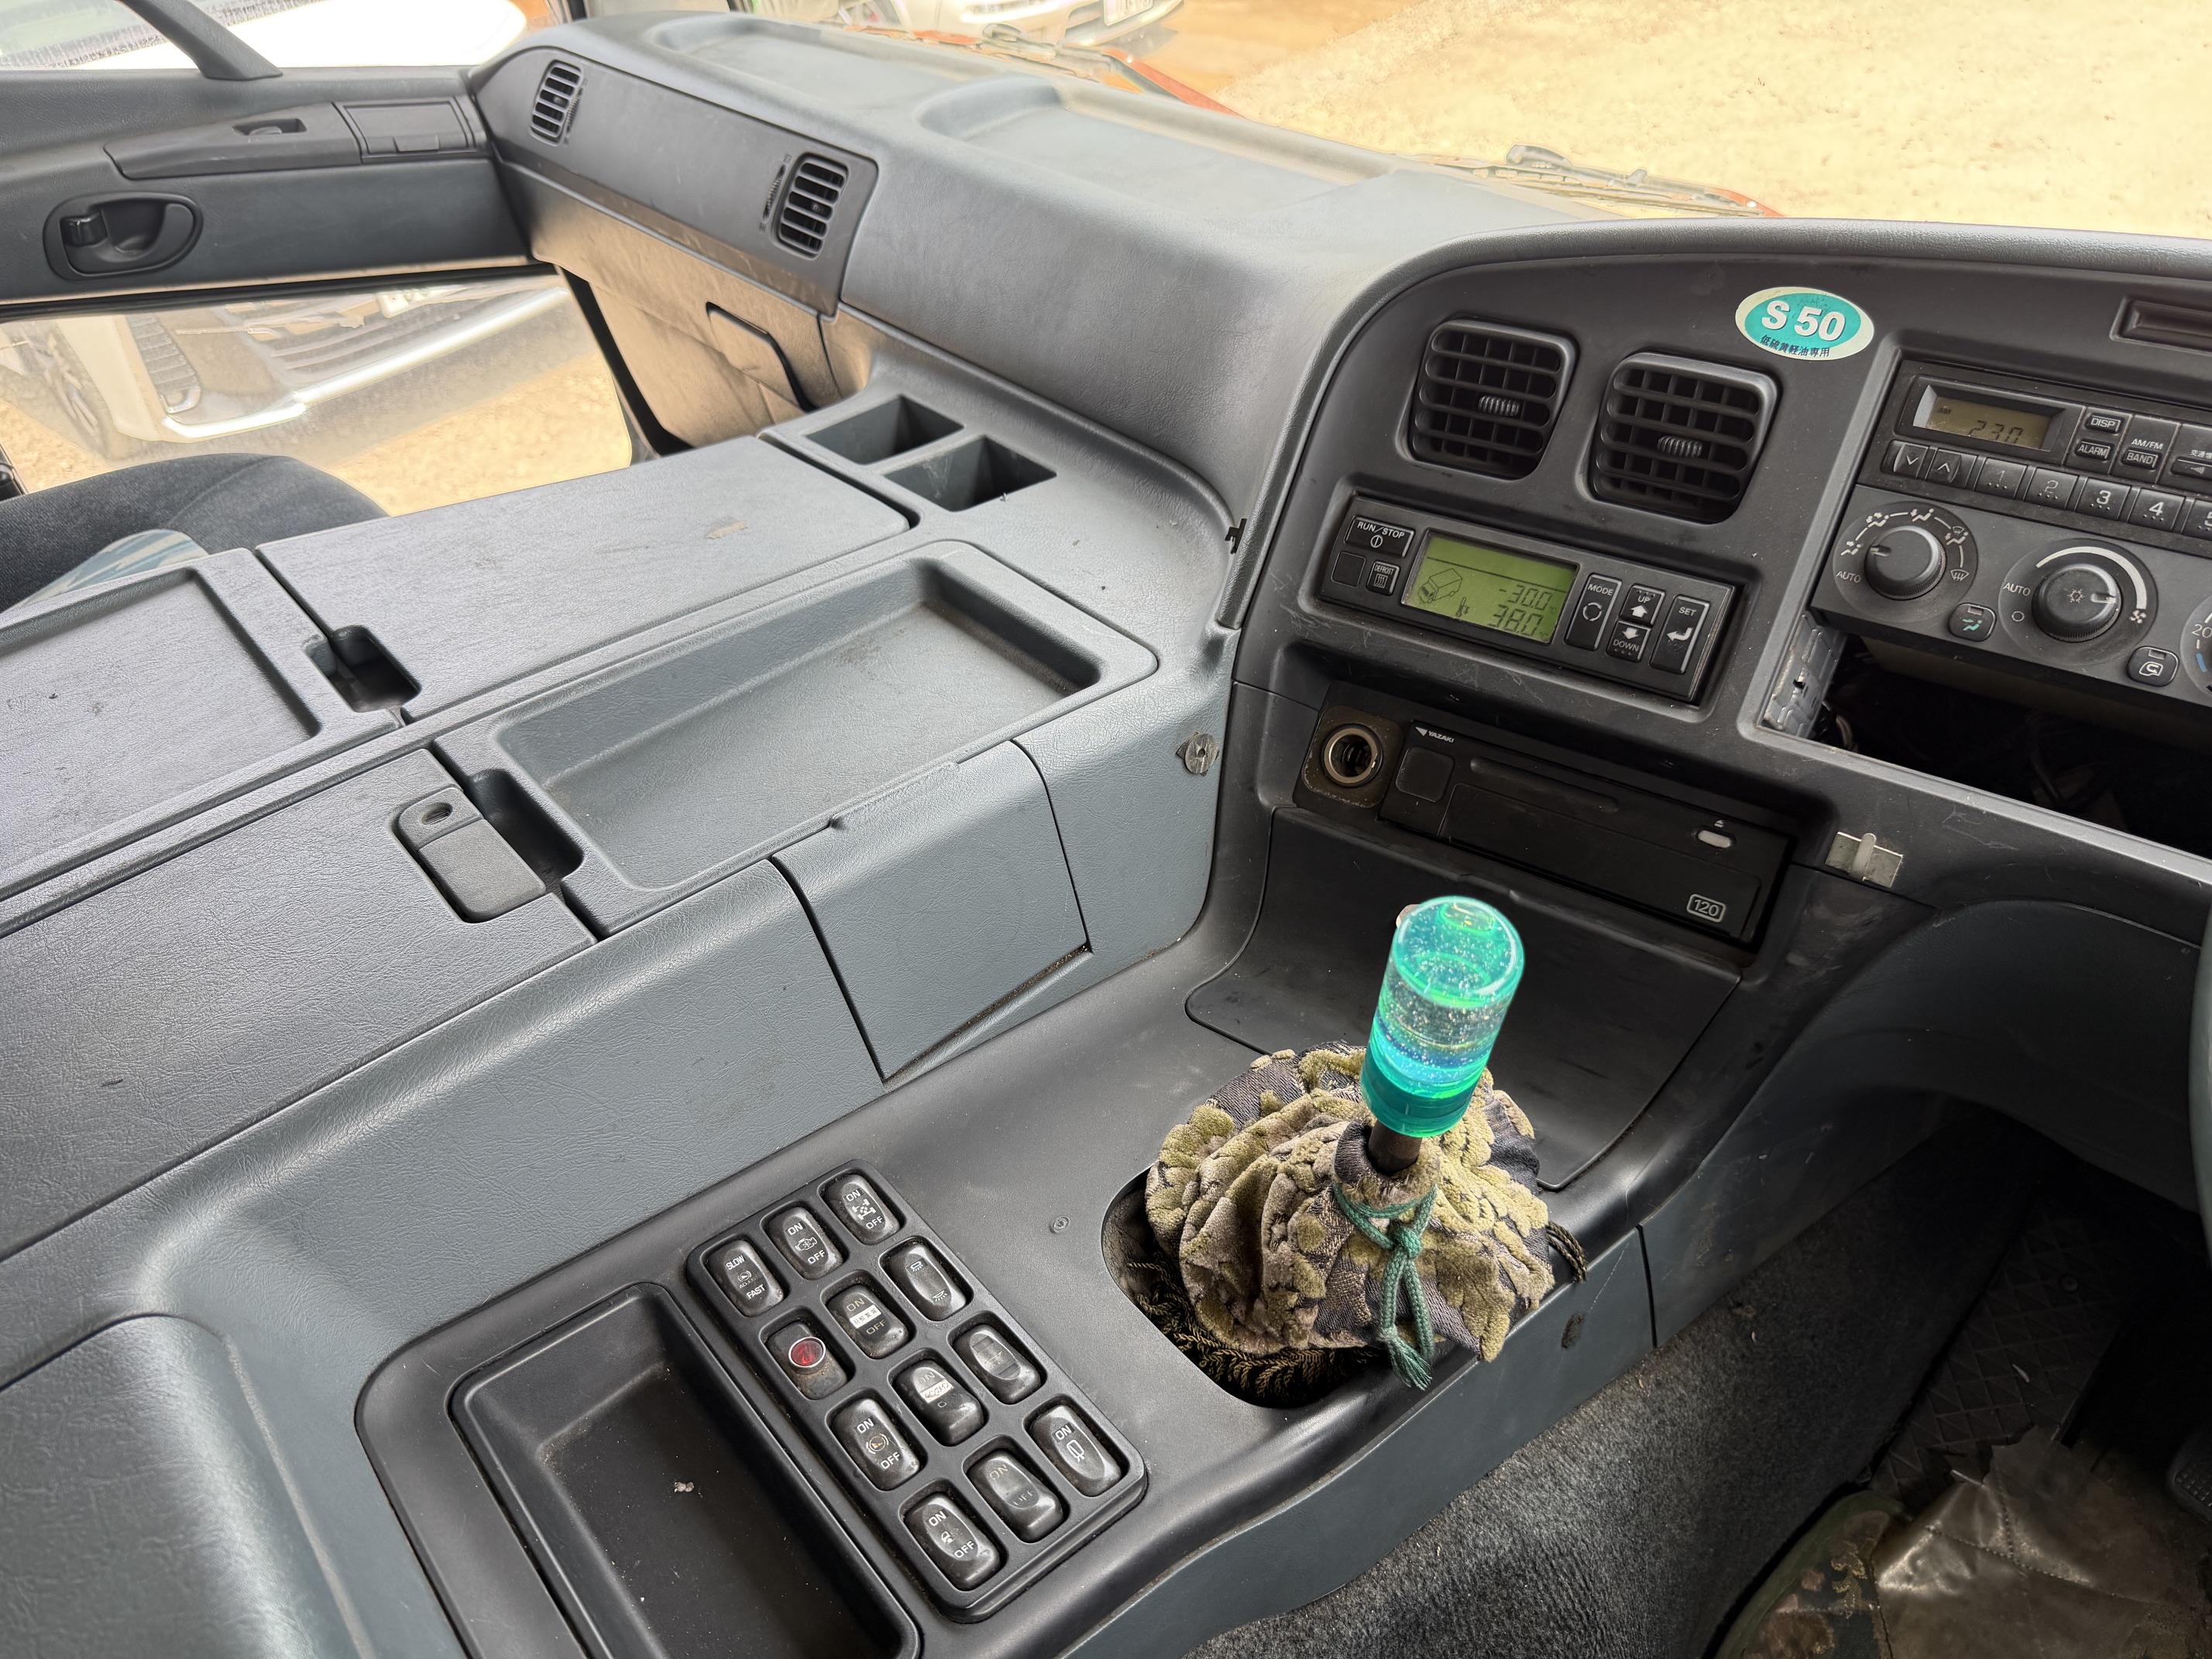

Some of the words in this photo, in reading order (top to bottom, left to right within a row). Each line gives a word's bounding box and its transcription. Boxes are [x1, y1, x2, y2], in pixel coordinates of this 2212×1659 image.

[1761, 300, 1790, 330] S
[1794, 306, 1846, 342] 50
[2090, 417, 2116, 428] DISP
[2077, 444, 2107, 457] ALARM
[2131, 438, 2164, 450] AM/FM
[2126, 452, 2154, 465] BAND
[2043, 479, 2059, 494] 2
[2096, 489, 2111, 505] 3
[2148, 501, 2165, 517] 4
[1357, 521, 1405, 538] RUN/STOP
[1374, 564, 1395, 575] DEFROST
[1836, 570, 1861, 583] AUTO
[1588, 583, 1614, 596] MODE
[2003, 582, 2031, 596] AUTO
[1637, 595, 1651, 603] UP
[1678, 606, 1697, 617] SET
[2191, 623, 2212, 638] 20
[1613, 639, 1640, 652] DOWN
[1428, 730, 1455, 744] YAZAKI
[1694, 899, 1719, 917] 120
[846, 1189, 861, 1202] ON
[787, 1222, 804, 1235] ON
[865, 1215, 883, 1230] OFF
[726, 1255, 745, 1270] SLOW
[807, 1249, 826, 1265] OFF
[746, 1283, 765, 1300] FAST
[847, 1298, 865, 1312] ON
[866, 1319, 886, 1334] OFF
[857, 1417, 874, 1433] ON
[1055, 1424, 1072, 1440] ON
[881, 1451, 900, 1469] OFF
[989, 1464, 1008, 1480] ON
[928, 1510, 947, 1527] ON
[954, 1540, 974, 1558] OFF
